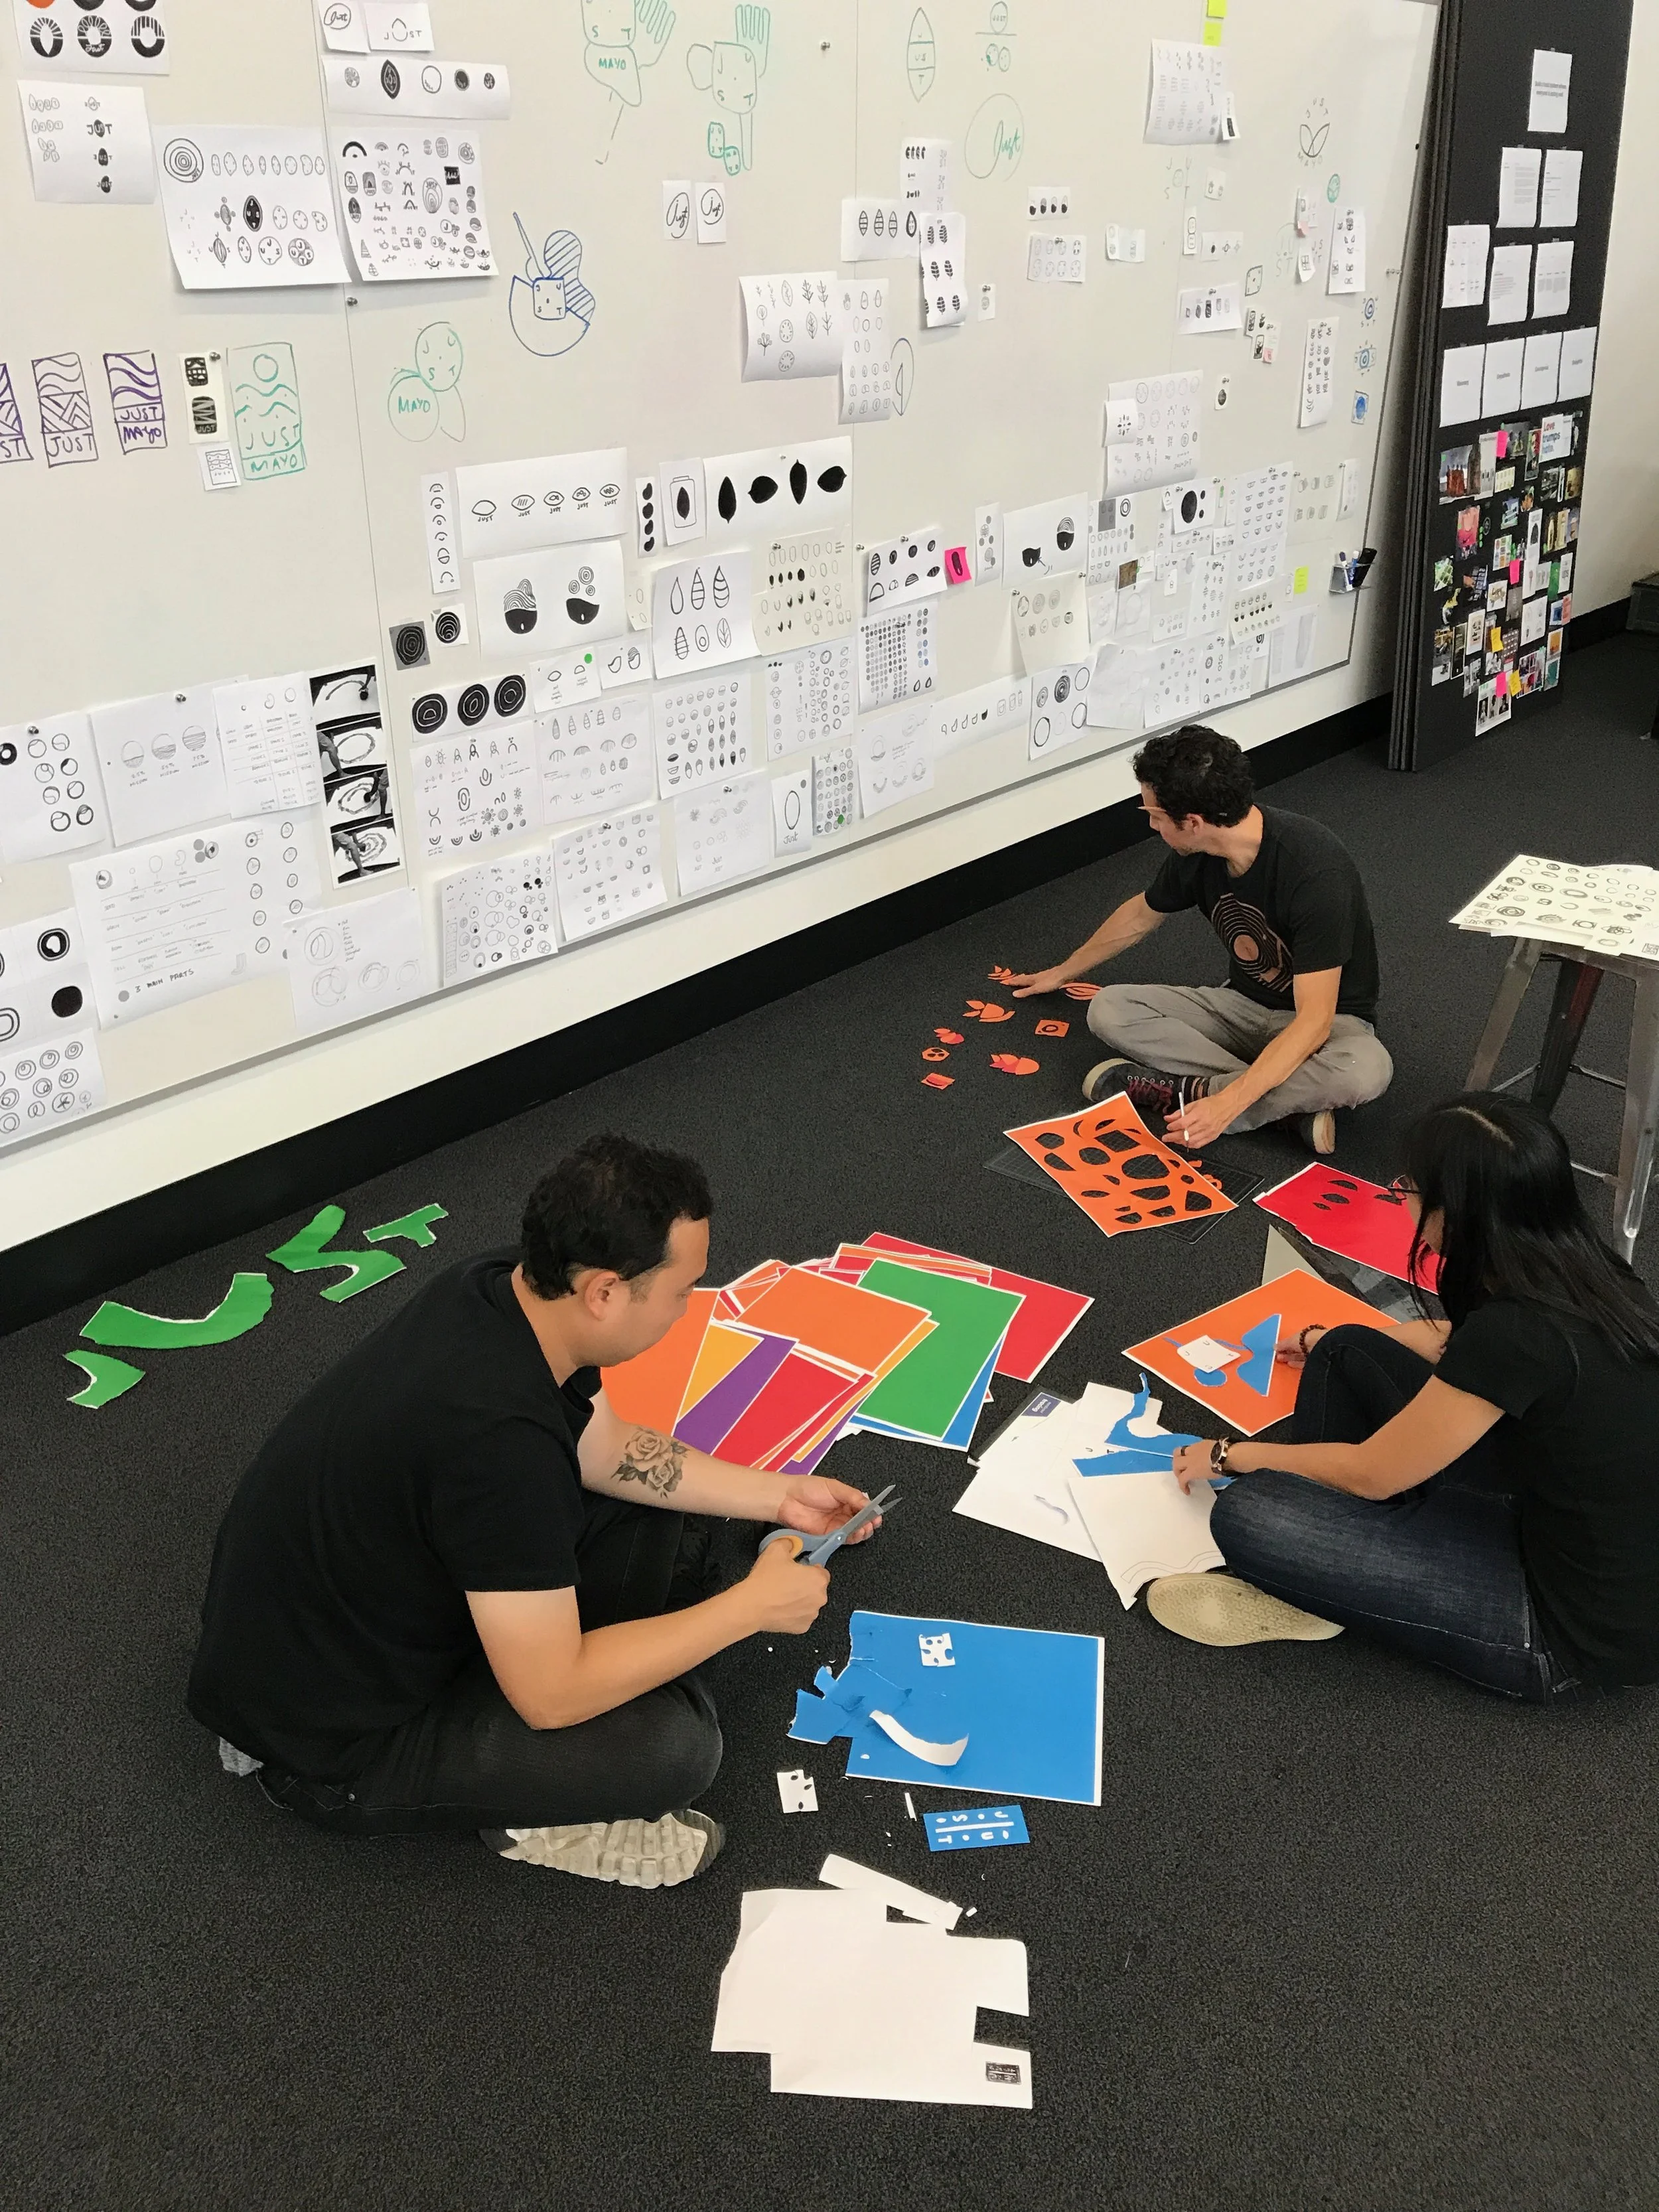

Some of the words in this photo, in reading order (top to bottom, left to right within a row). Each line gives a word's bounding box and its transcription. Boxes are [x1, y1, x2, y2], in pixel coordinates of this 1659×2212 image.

[599, 58, 626, 70] MAYO
[120, 406, 158, 420] JUST
[397, 396, 431, 414] MAYO
[198, 424, 216, 433] JUST
[1544, 421, 1555, 431] Love
[246, 423, 299, 450] JUST
[47, 433, 94, 457] JUST
[250, 453, 298, 473] MAYO
[783, 831, 799, 845] Just
[147, 978, 164, 989] MAIN
[169, 968, 195, 982] PARTS
